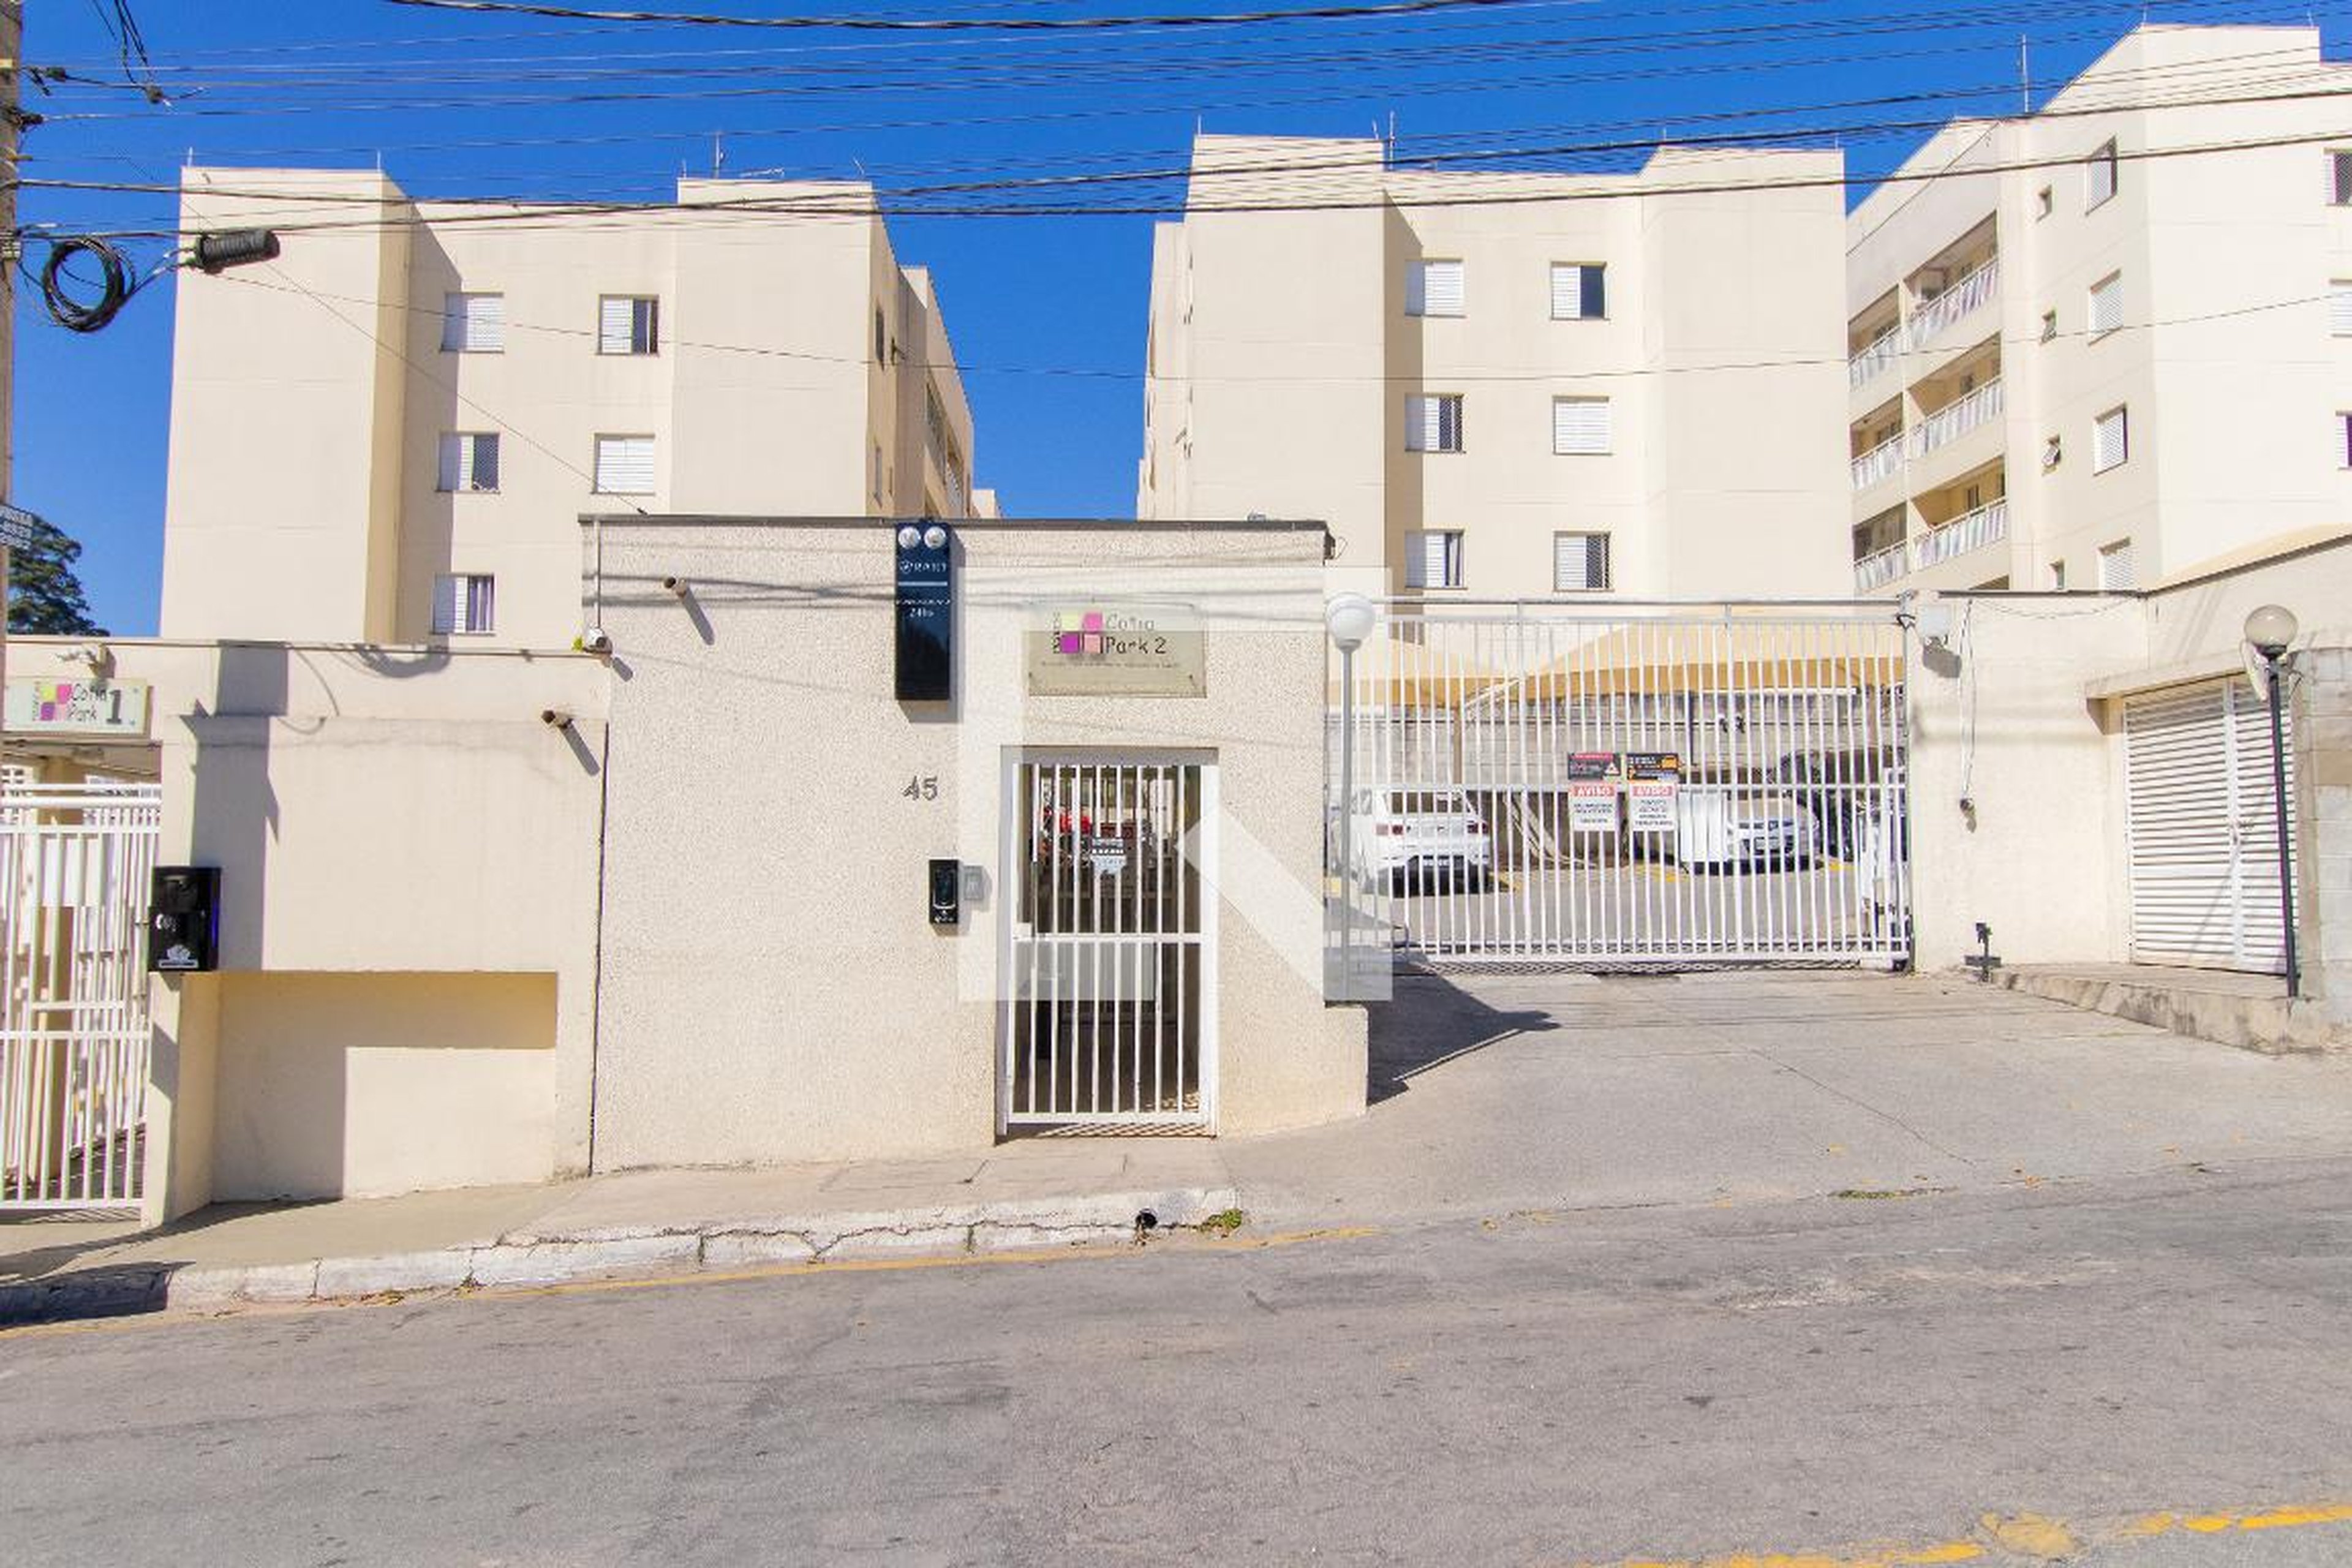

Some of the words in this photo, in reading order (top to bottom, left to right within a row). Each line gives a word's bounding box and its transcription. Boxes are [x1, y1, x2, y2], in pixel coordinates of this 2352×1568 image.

[1107, 612, 1155, 631] Cotia
[1106, 636, 1149, 654] Park
[1155, 636, 1167, 655] 2
[67, 703, 97, 722] Park
[106, 689, 123, 725] 1
[902, 775, 938, 801] 45
[1577, 786, 1611, 796] AVISO
[1636, 786, 1670, 796] AVISO
